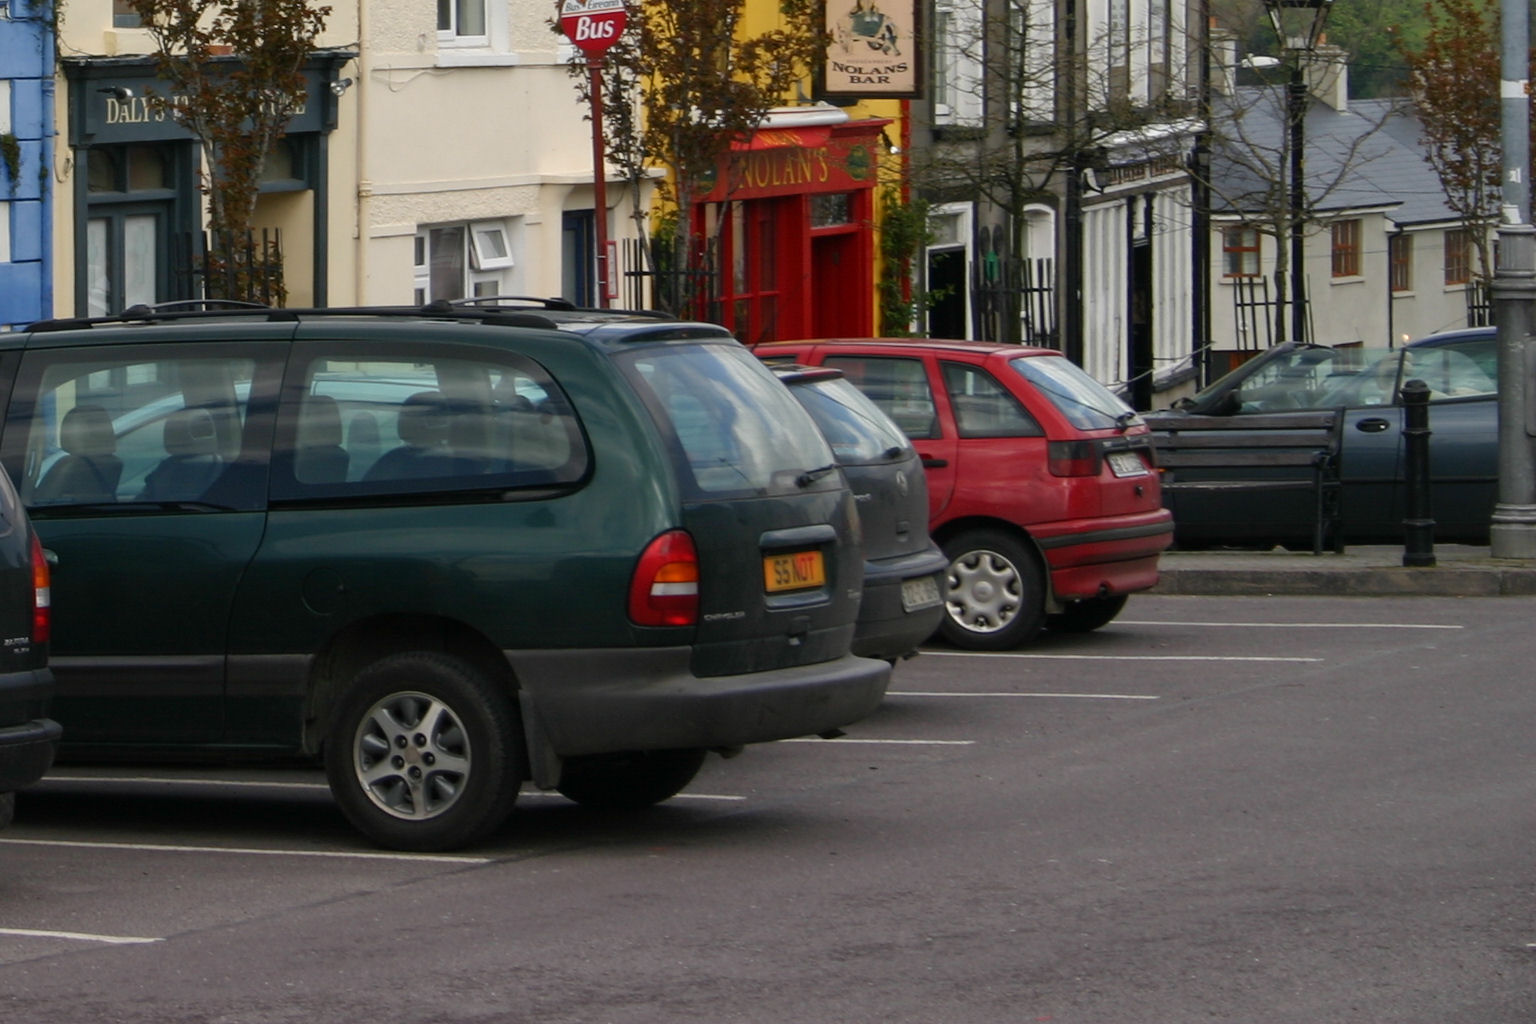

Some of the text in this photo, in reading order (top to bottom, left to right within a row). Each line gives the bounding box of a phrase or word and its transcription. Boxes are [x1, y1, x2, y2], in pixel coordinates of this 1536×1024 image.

[575, 16, 615, 41] Bus
[832, 60, 909, 75] NOLANS
[849, 75, 891, 84] BAR
